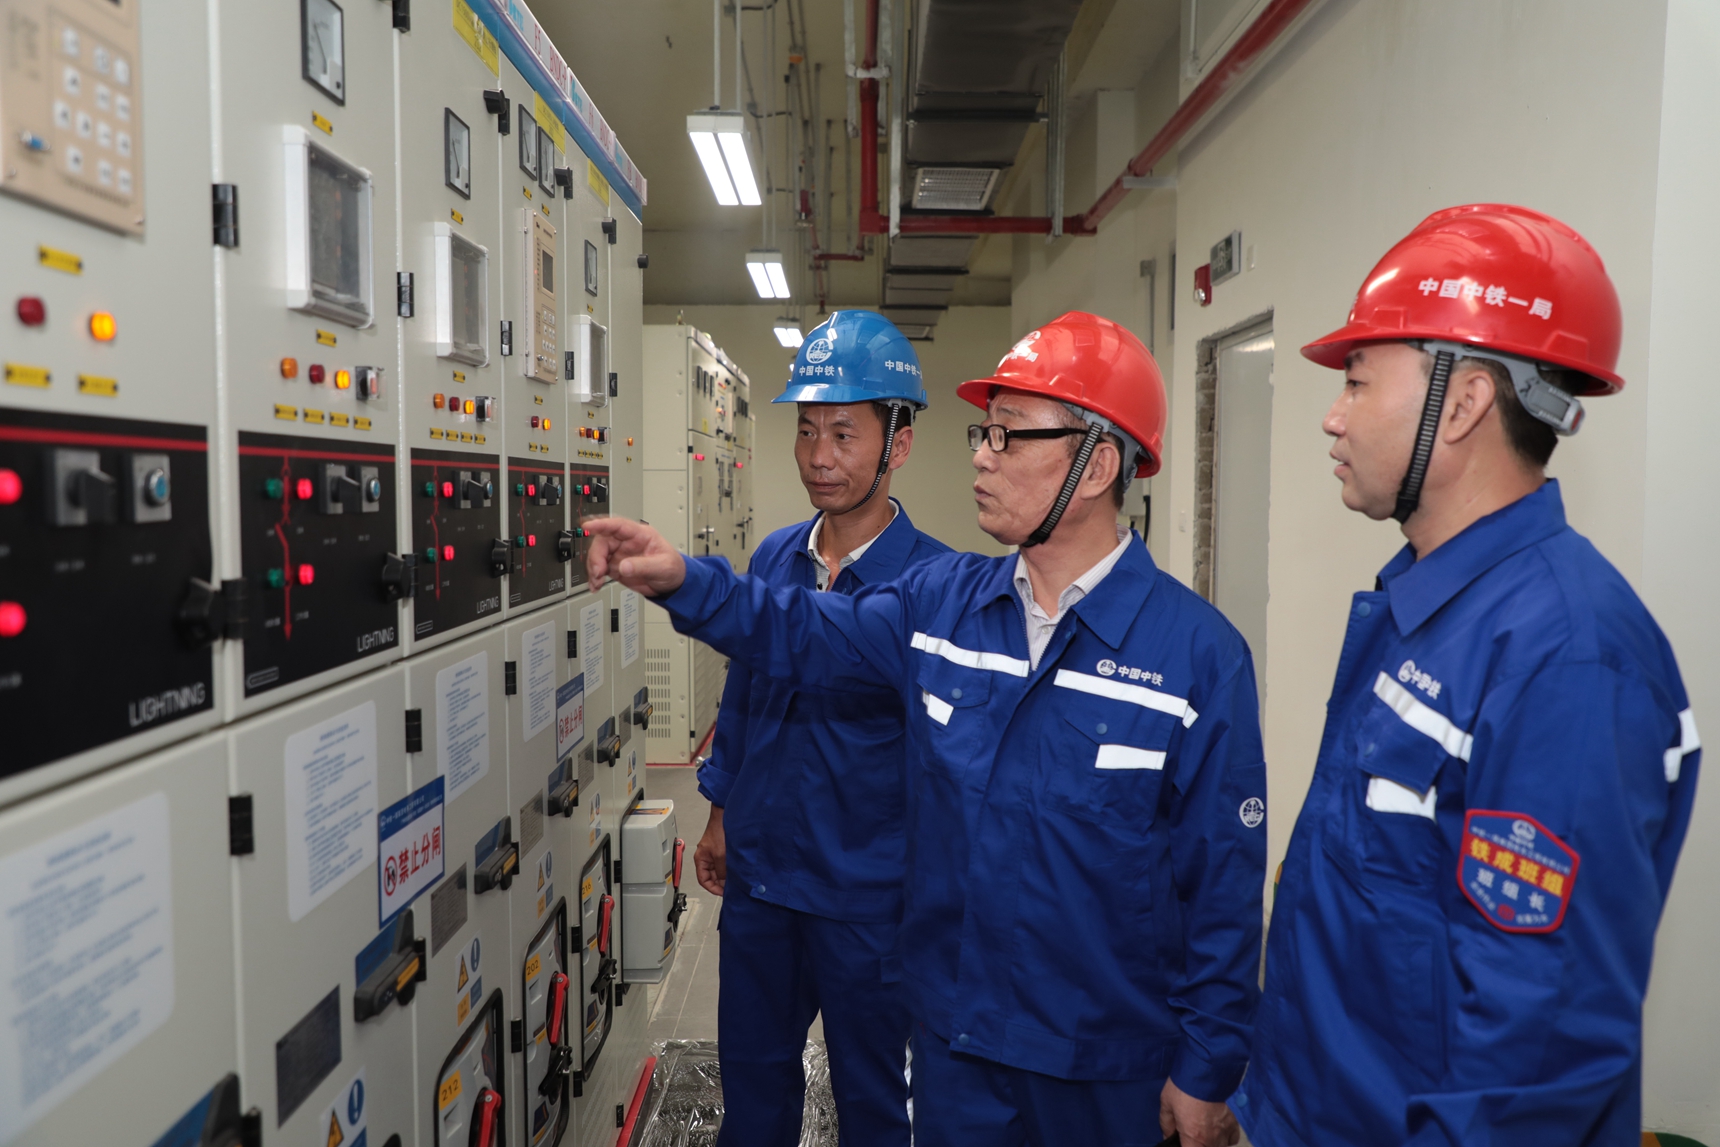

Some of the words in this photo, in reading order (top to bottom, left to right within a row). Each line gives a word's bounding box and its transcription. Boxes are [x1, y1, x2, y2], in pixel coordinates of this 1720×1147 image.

[1418, 277, 1553, 320] 中国中铁一局
[799, 365, 835, 377] 中国中铁
[885, 360, 922, 379] 中国中铁一
[476, 596, 499, 614] LIGHTNING
[357, 627, 395, 653] LIGHTNING
[1118, 665, 1164, 687] 中国中铁
[128, 681, 206, 728] LIGHTNING
[526, 960, 539, 976] 202
[442, 1079, 458, 1102] 212
